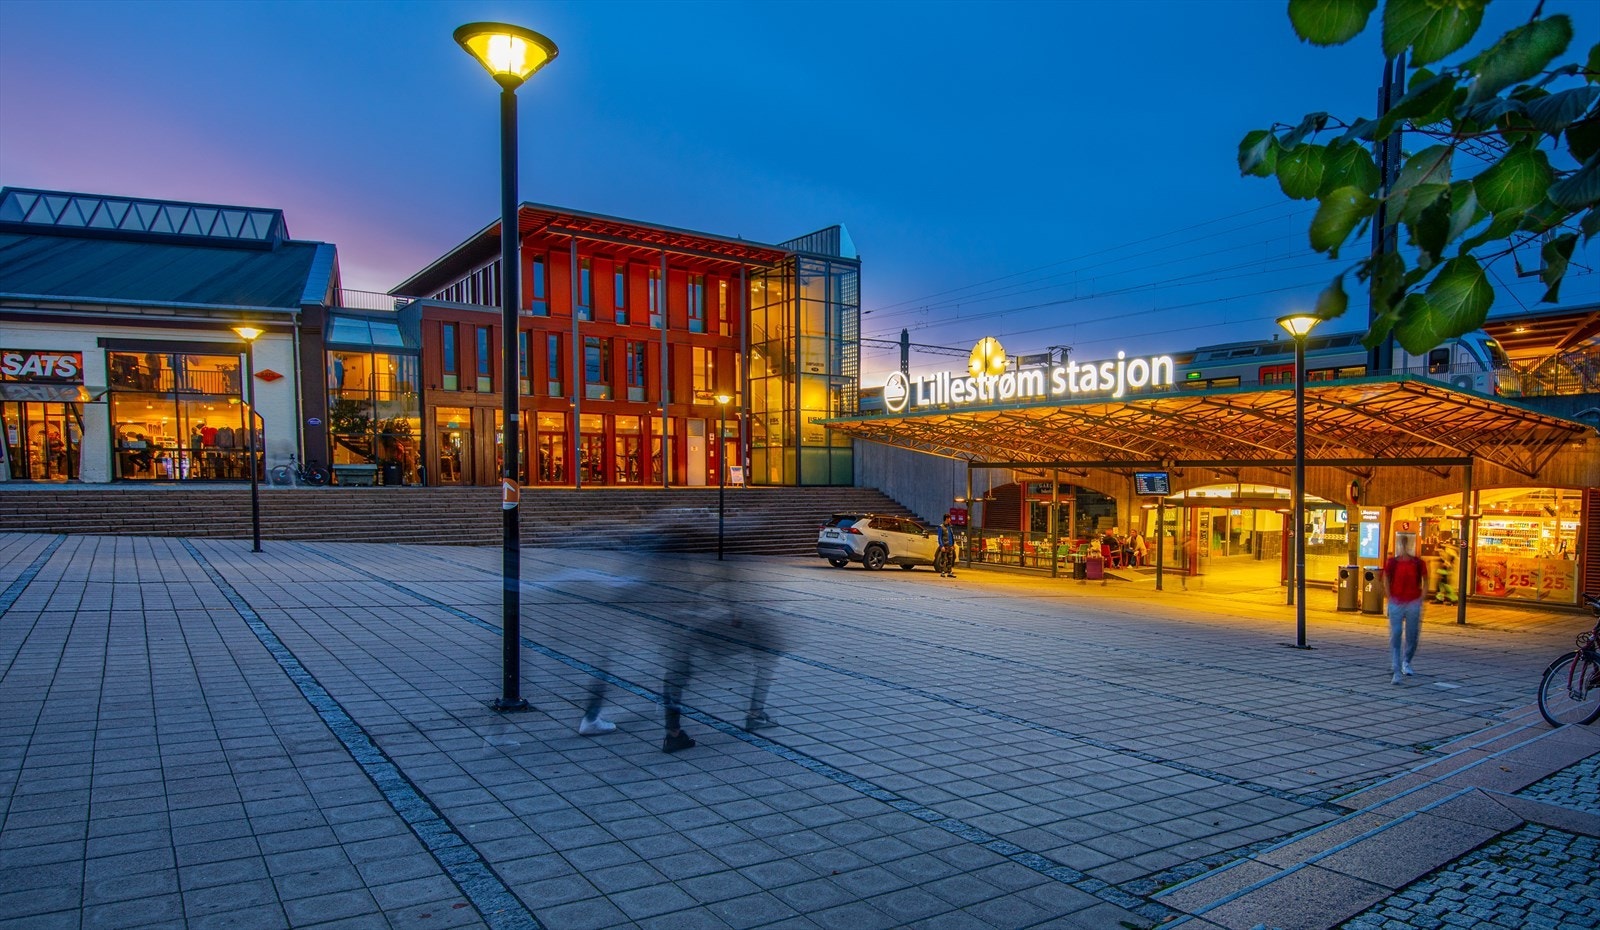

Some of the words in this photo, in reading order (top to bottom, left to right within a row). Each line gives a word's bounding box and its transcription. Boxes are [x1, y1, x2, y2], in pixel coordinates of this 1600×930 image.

[1, 353, 77, 378] SATS
[917, 370, 1044, 406] Lillestrøm
[1052, 350, 1174, 398] stasjon
